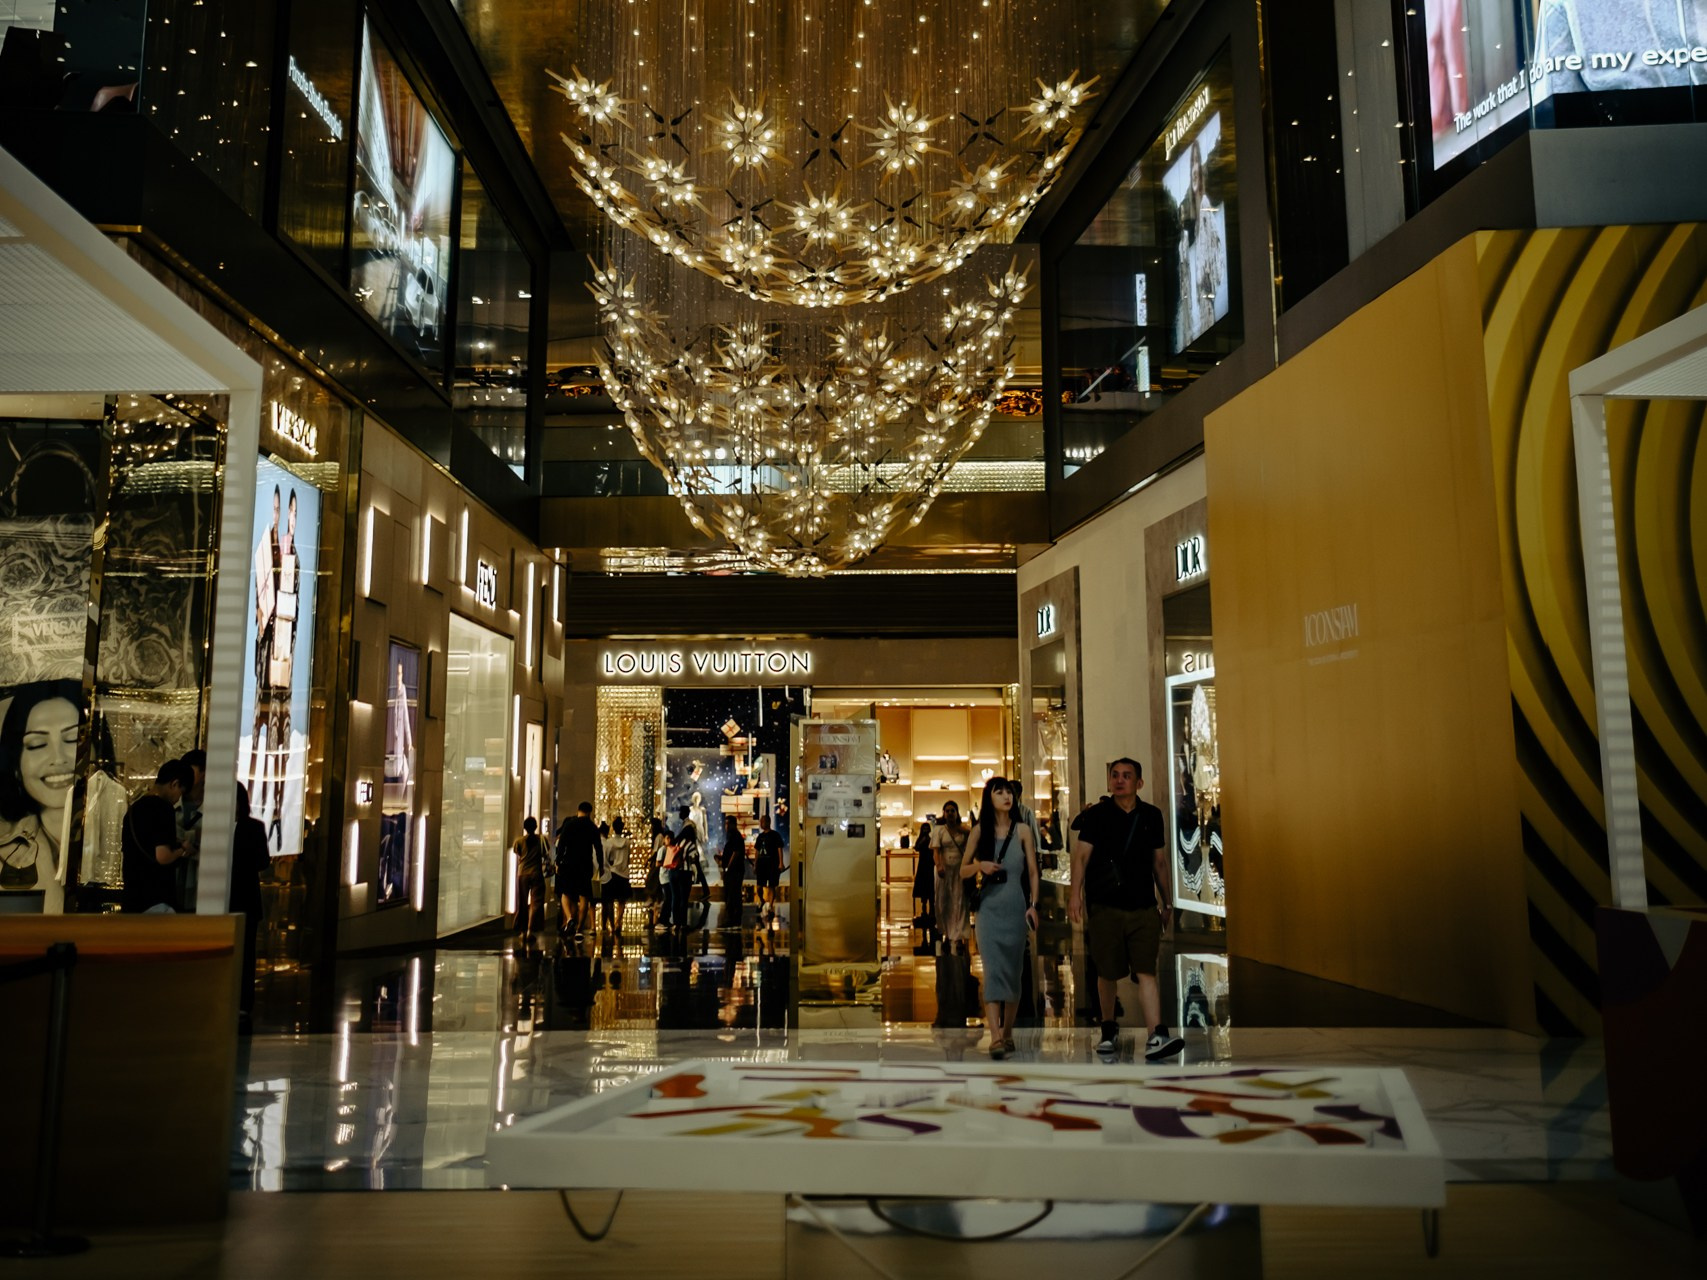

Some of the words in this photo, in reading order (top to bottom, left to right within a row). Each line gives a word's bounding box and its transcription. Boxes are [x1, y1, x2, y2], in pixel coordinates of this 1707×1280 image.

[1453, 112, 1472, 134] The
[1473, 91, 1497, 121] work
[1497, 75, 1518, 104] that
[1519, 69, 1526, 90] I
[1529, 61, 1543, 84] do
[1545, 53, 1583, 72] are
[1592, 50, 1633, 72] my
[1642, 45, 1707, 69] expe
[1175, 535, 1204, 581] DIOR
[33, 619, 86, 637] VERSAC
[605, 652, 682, 673] LOUIS
[693, 651, 809, 673] VUITTON
